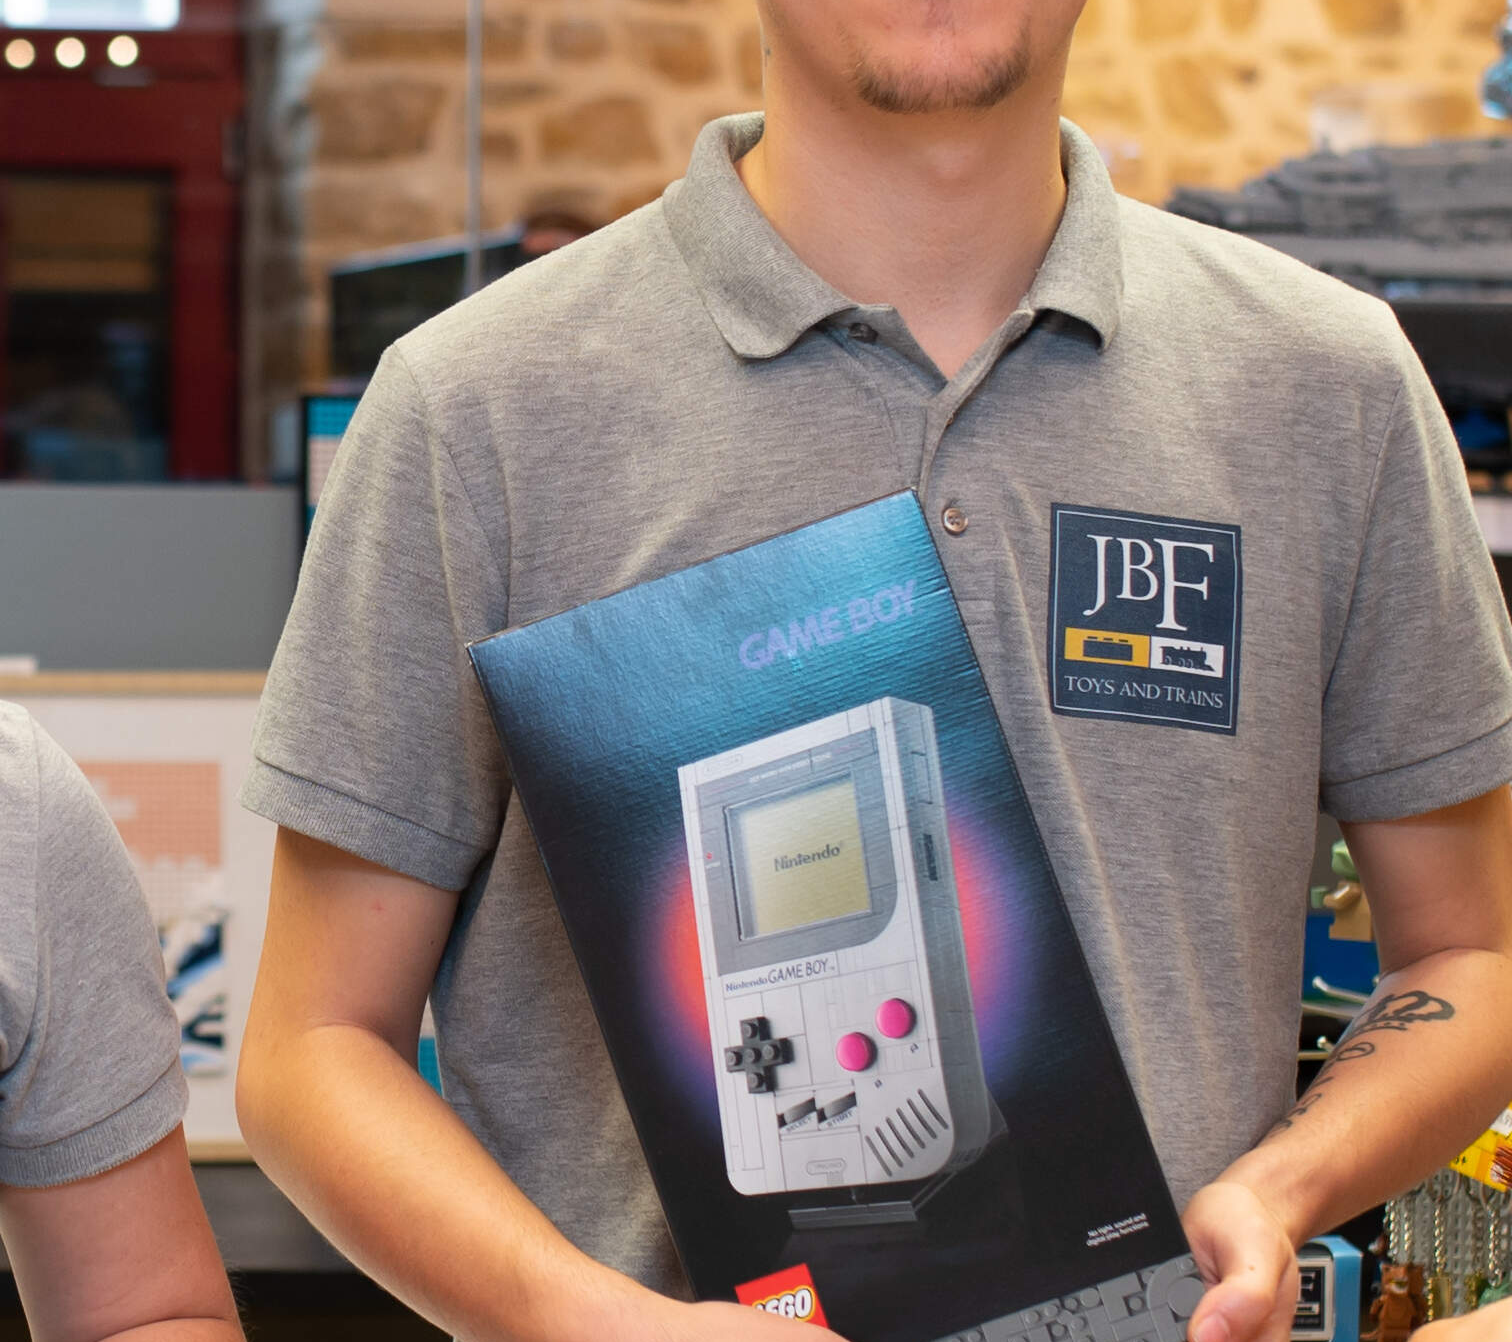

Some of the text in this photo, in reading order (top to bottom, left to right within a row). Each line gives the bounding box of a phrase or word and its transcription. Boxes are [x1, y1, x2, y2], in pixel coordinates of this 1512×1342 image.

[1083, 534, 1215, 631] JBF
[738, 579, 917, 670] GAME BOY
[1064, 675, 1224, 709] TOYS AND TRAINS
[774, 843, 841, 872] Nintendo
[726, 958, 829, 992] Nintendo GAME BOY
[756, 1288, 813, 1320] EGO
